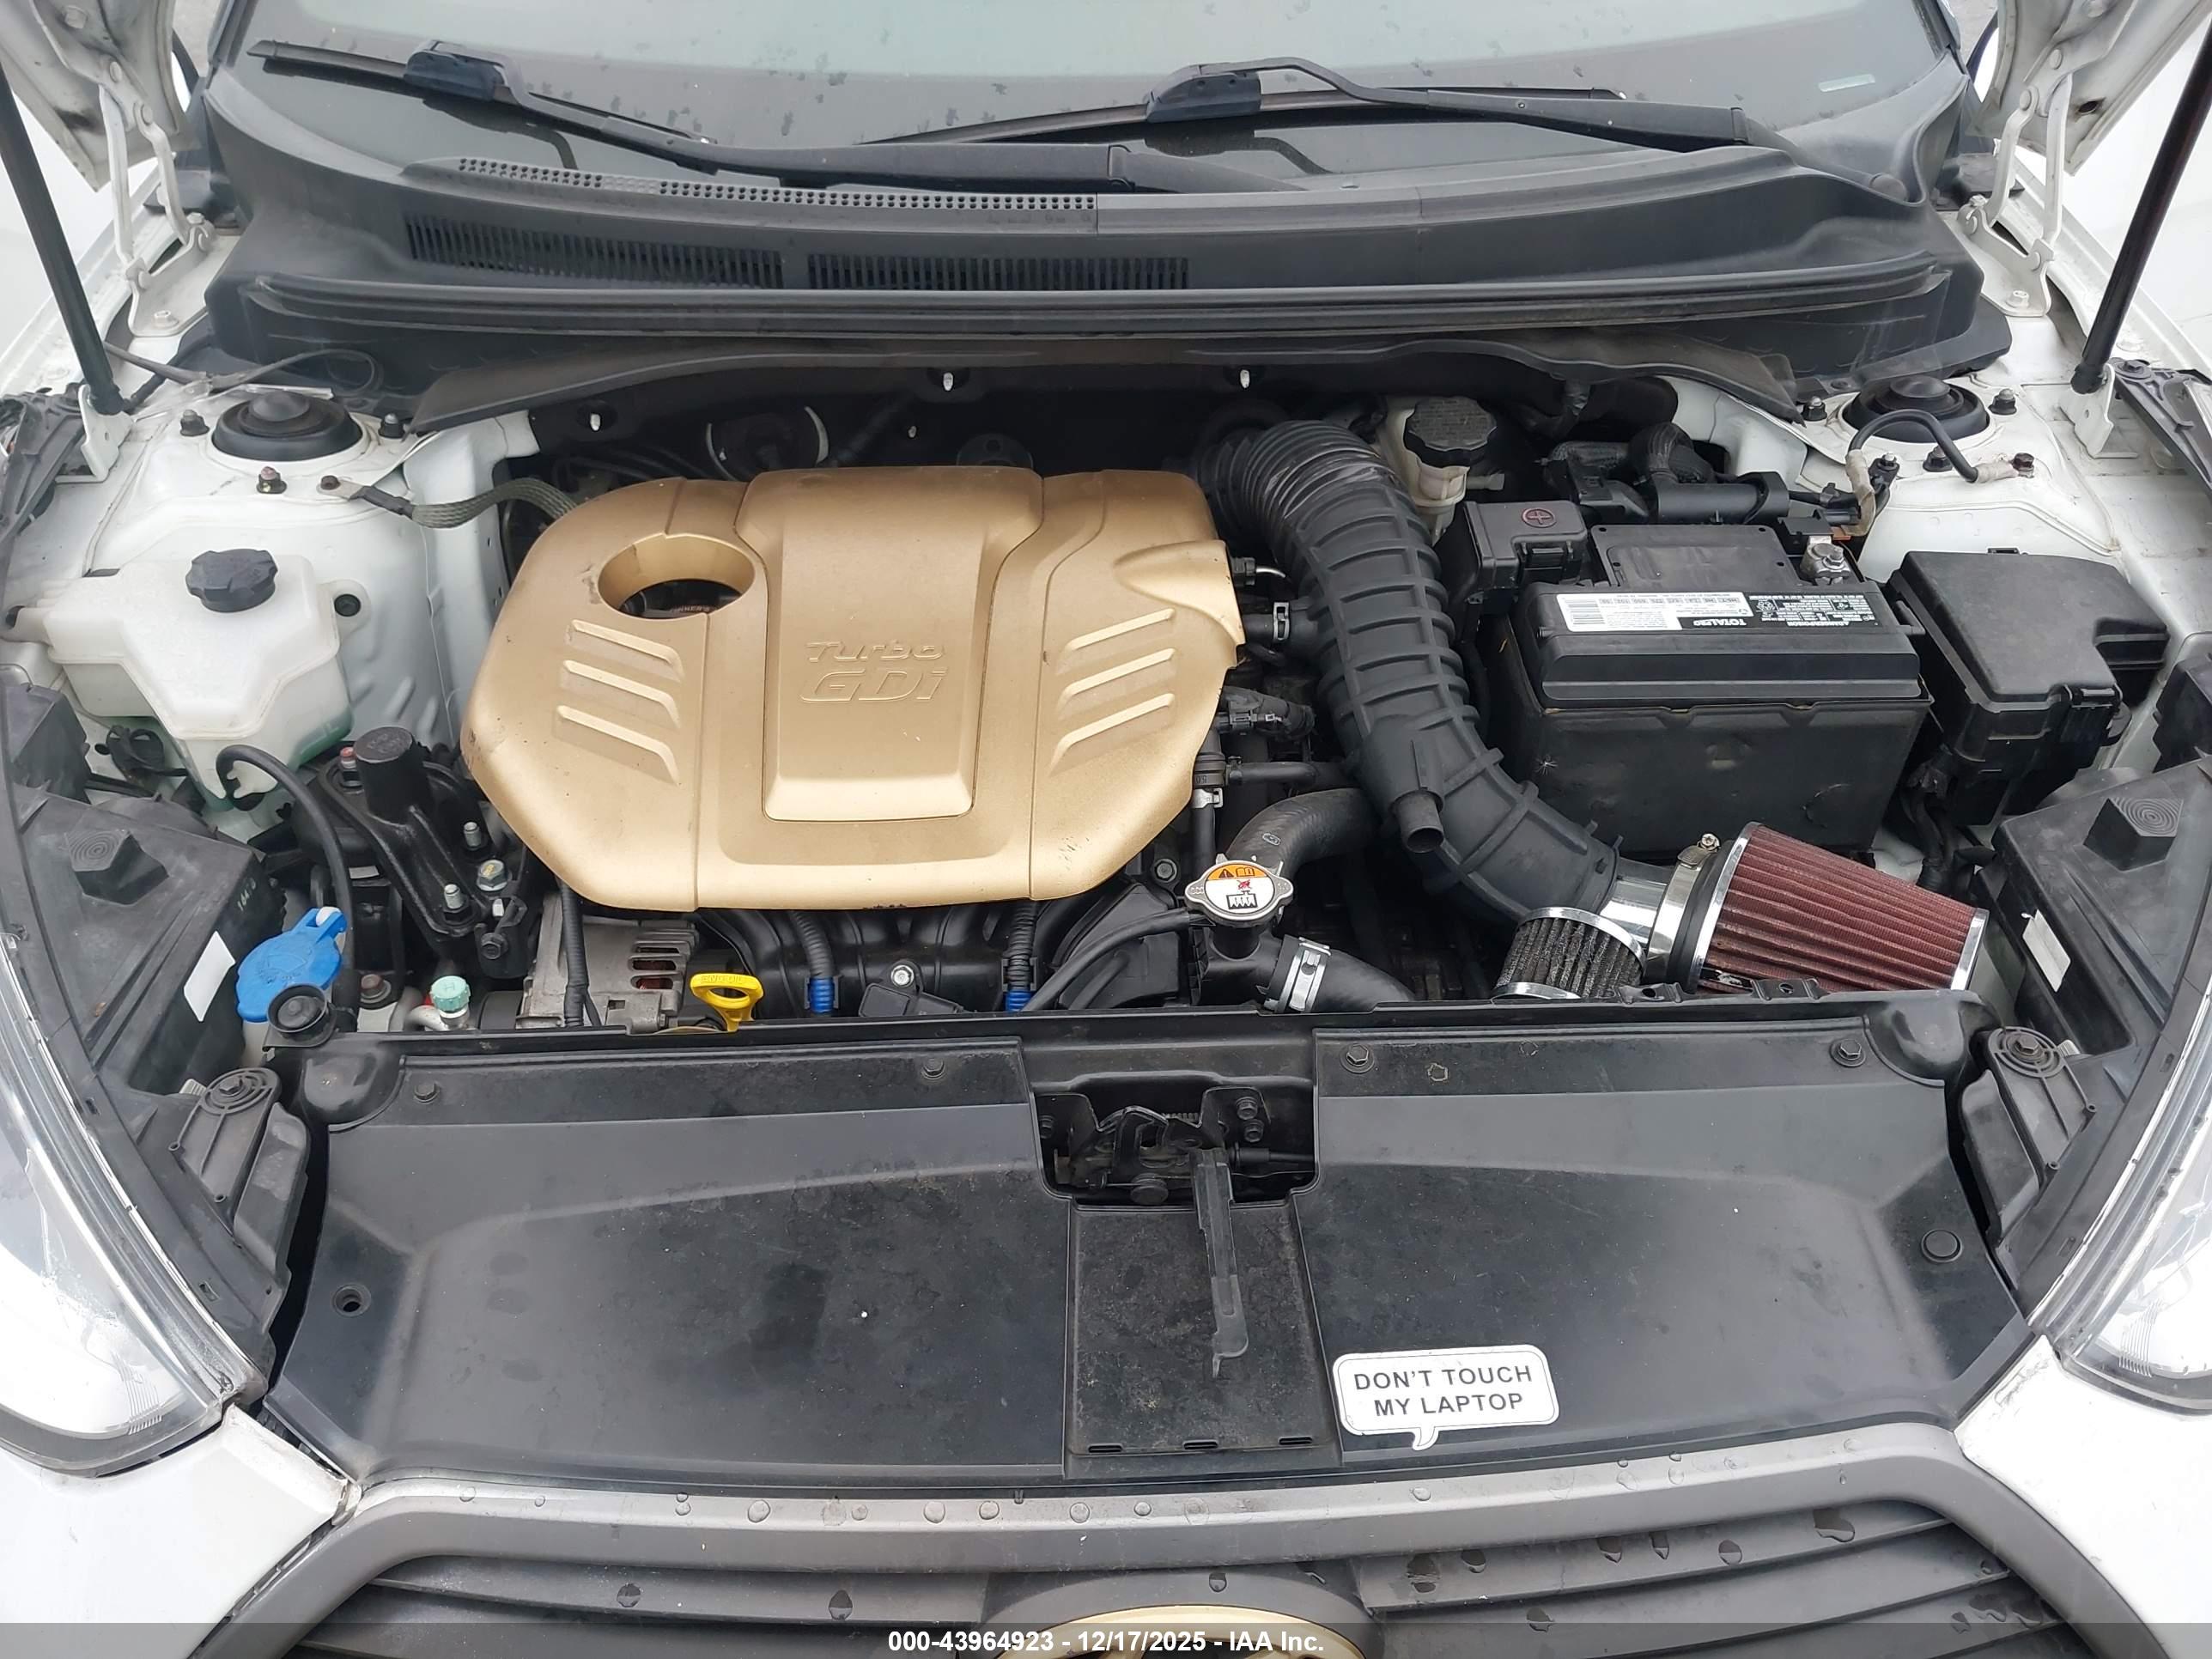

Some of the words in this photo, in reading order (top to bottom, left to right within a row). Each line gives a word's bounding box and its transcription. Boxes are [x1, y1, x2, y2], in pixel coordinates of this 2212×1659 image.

[806, 640, 945, 662] Turbo
[1354, 1370, 1432, 1390] DON'T
[1442, 1365, 1532, 1386] TOUCH
[1374, 1398, 1410, 1417] MY
[1421, 1393, 1522, 1414] LAPTOP
